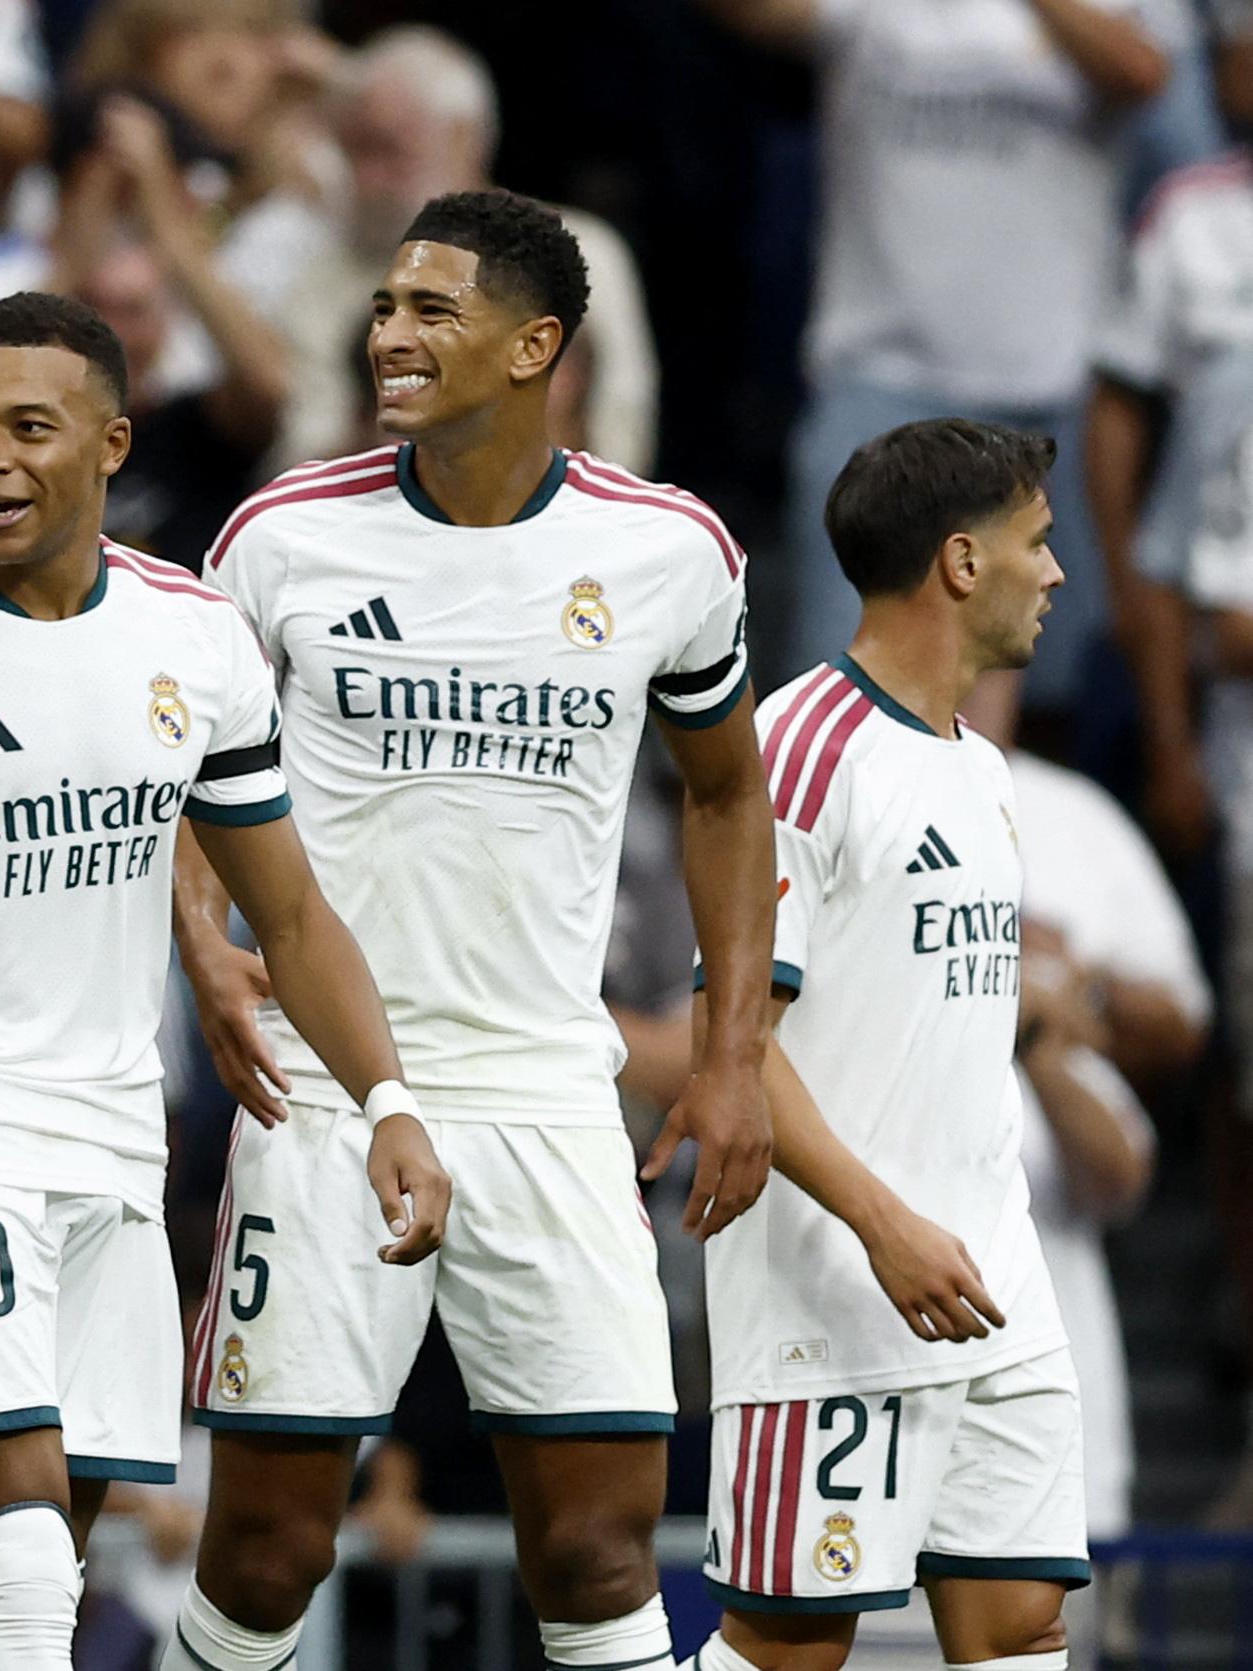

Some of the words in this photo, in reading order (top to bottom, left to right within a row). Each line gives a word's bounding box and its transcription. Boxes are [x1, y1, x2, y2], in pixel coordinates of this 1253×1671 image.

[332, 667, 615, 729] Emirates
[382, 730, 436, 770] FLY
[451, 731, 573, 777] BETTER
[3, 849, 53, 898] FLY
[65, 835, 158, 889] BETER
[230, 1213, 275, 1322] 5
[816, 1395, 902, 1501] 21
